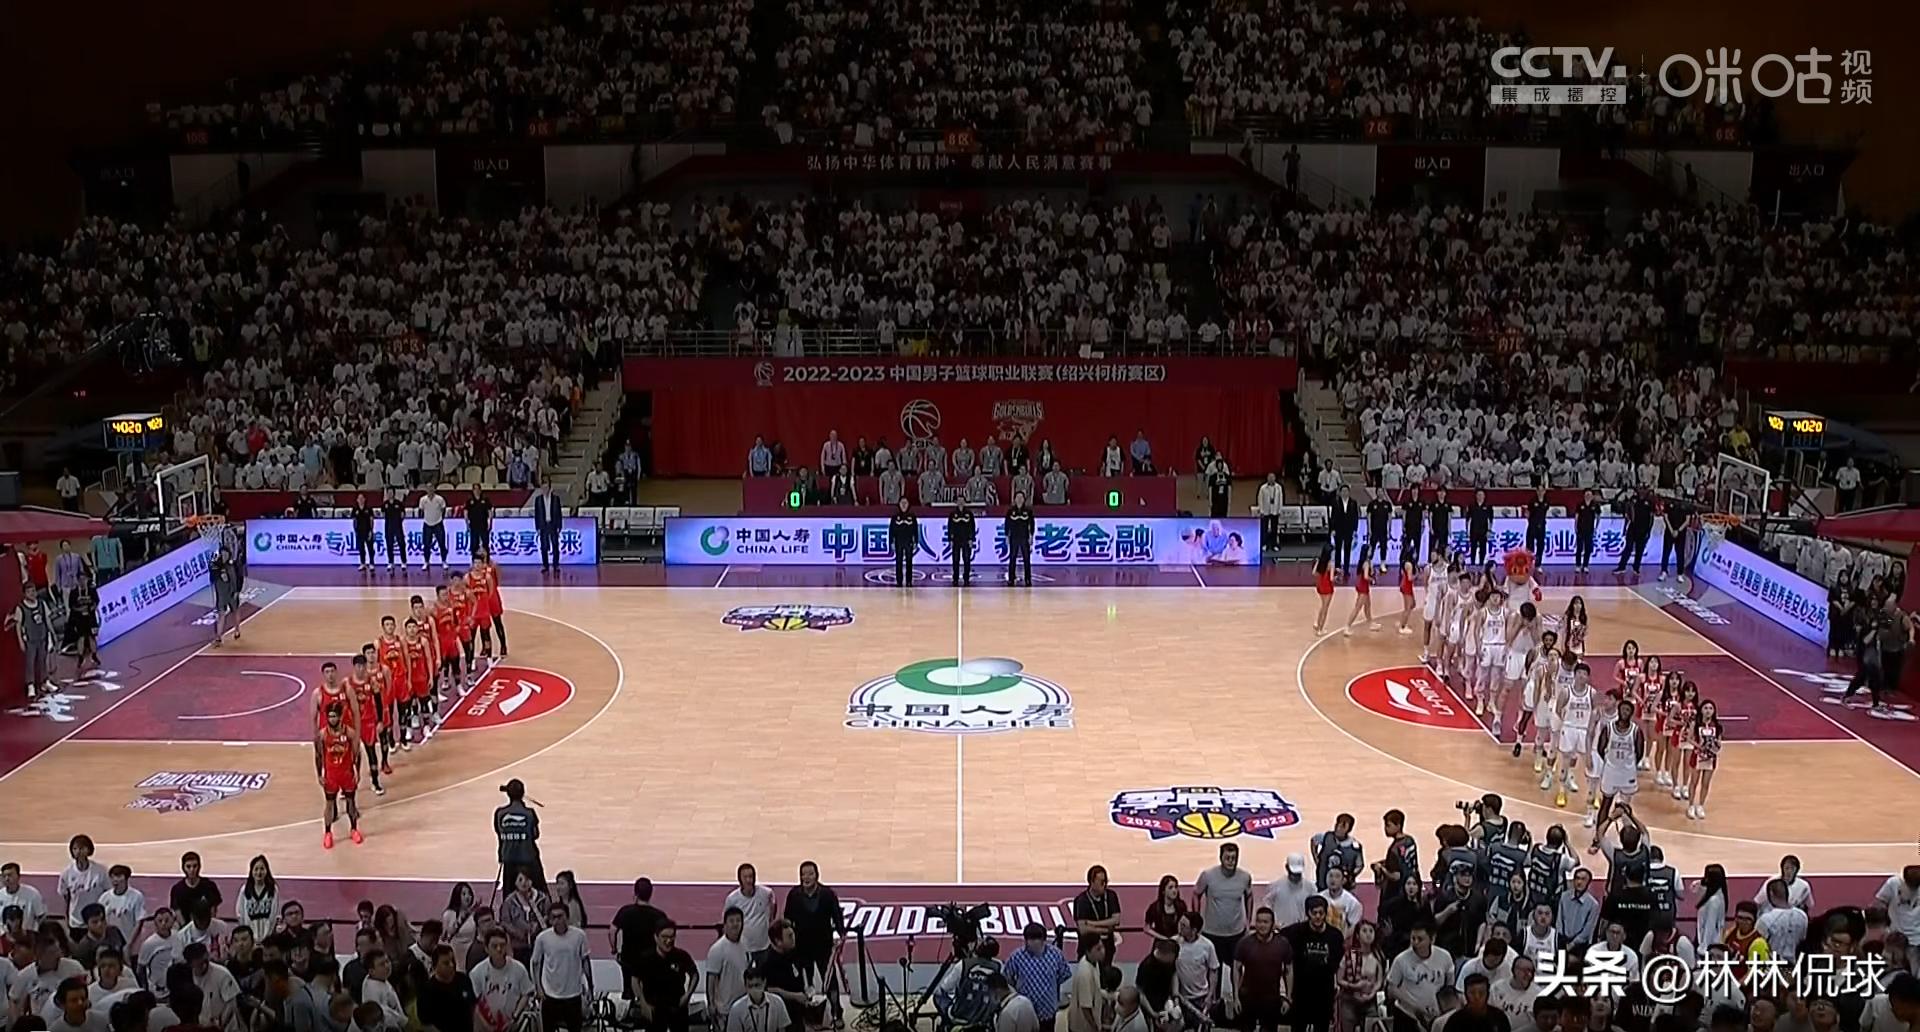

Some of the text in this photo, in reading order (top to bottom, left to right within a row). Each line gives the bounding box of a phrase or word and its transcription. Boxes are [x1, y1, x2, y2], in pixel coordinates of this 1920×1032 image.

[473, 158, 510, 173] 出入口
[1414, 156, 1451, 171] 出入口
[1788, 162, 1825, 177] 出入口
[783, 365, 886, 383] 2022-2023
[791, 493, 800, 507] 0
[1109, 492, 1118, 507] 0
[276, 534, 322, 544] 中国人寿
[736, 528, 810, 543] 中国人寿
[737, 545, 809, 554] CHINA LIFE
[848, 703, 1072, 717] 中国人寿
[845, 719, 1073, 728] CHINA LIFE
[137, 772, 269, 790] GOLDENBULLS
[1125, 815, 1287, 829] 2022 2023
